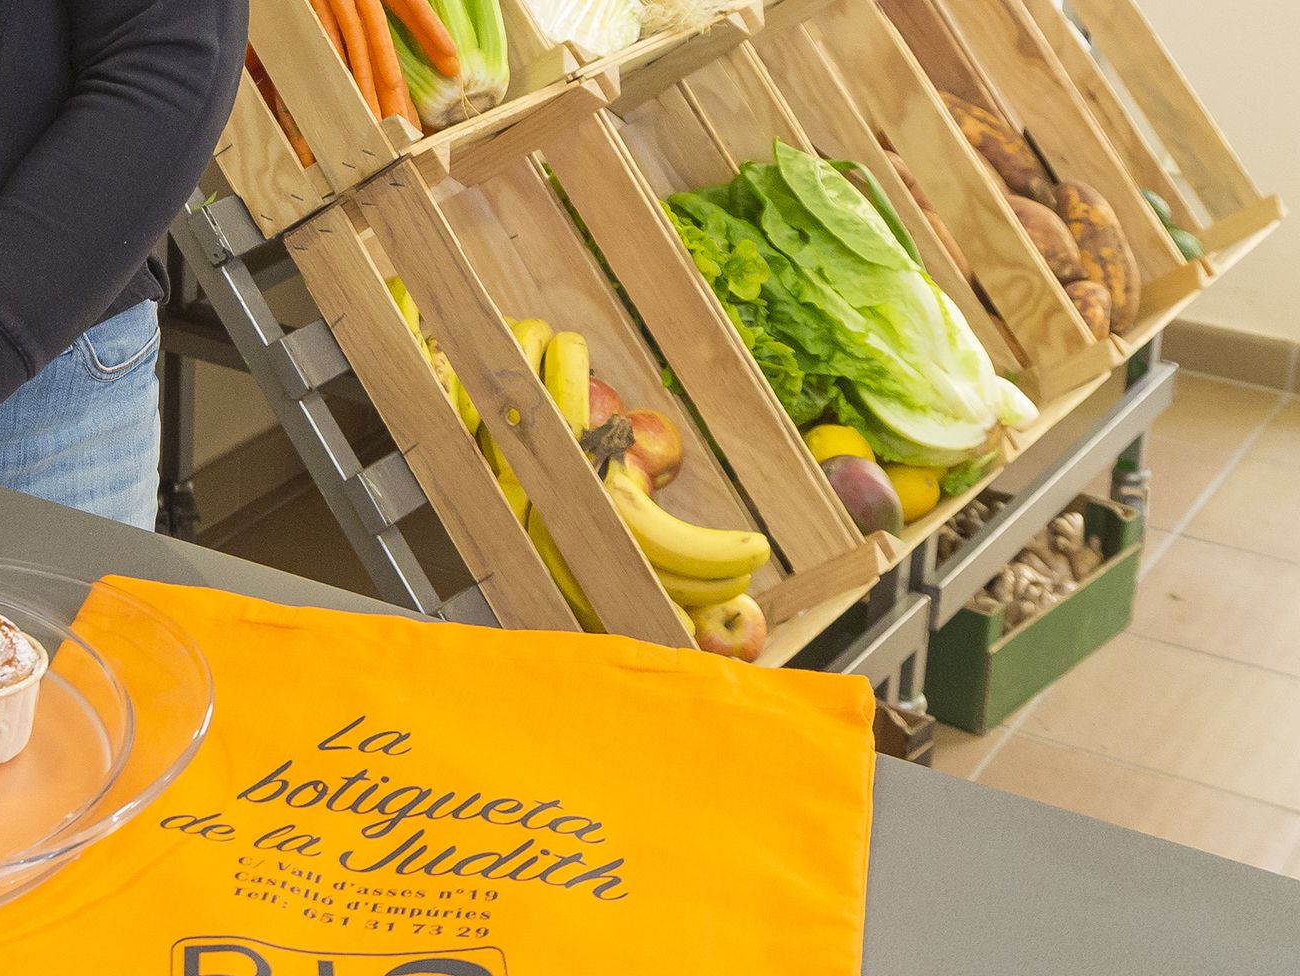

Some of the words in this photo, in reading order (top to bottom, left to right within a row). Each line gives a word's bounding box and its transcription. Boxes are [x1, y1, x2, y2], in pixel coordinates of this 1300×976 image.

[317, 715, 412, 755] La
[236, 759, 605, 844] botigueta
[159, 812, 236, 842] de
[253, 824, 322, 857] la
[338, 828, 629, 901] Judith
[234, 871, 334, 906] Castelló
[303, 908, 350, 926] 651
[364, 919, 395, 932] 31
[412, 923, 444, 936] 73
[456, 926, 490, 939] 29
